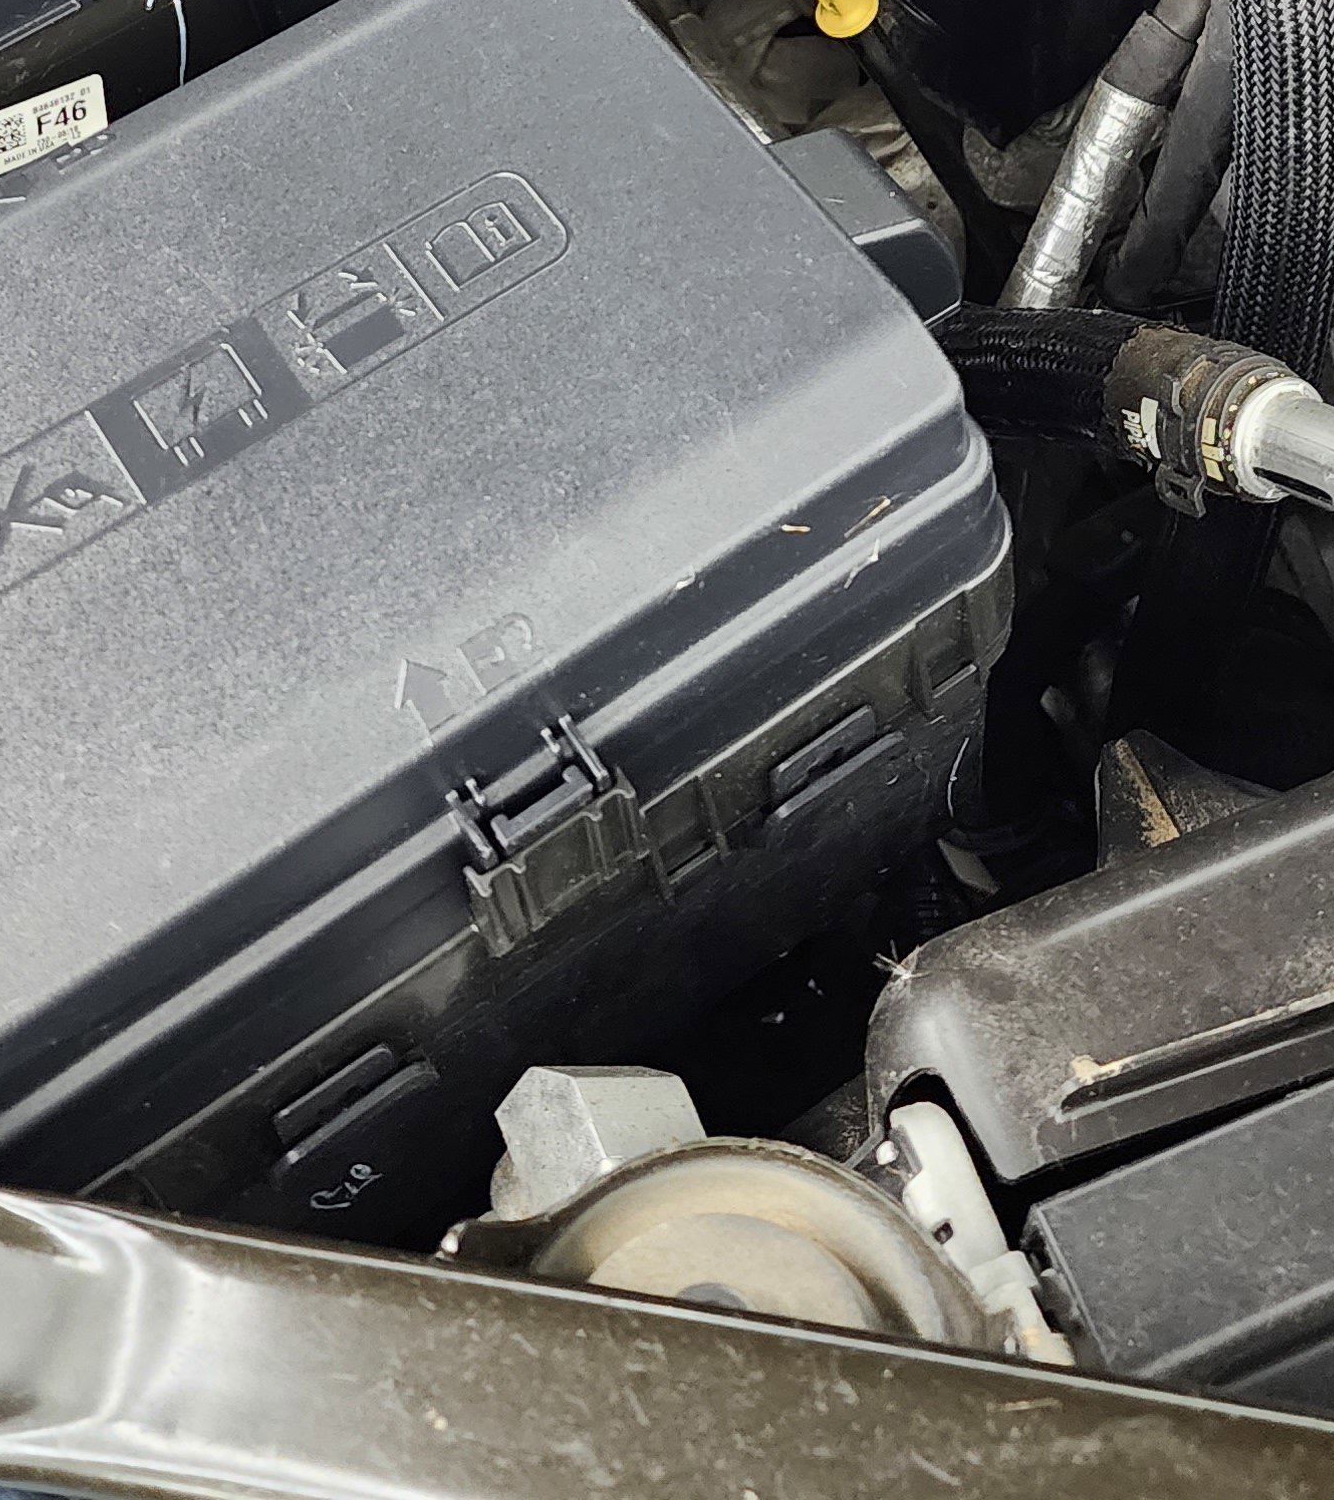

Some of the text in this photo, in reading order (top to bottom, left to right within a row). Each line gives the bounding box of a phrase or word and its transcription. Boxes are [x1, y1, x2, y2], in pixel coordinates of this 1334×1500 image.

[37, 100, 86, 135] F46
[4, 153, 25, 165] MADE
[28, 148, 37, 156] IN
